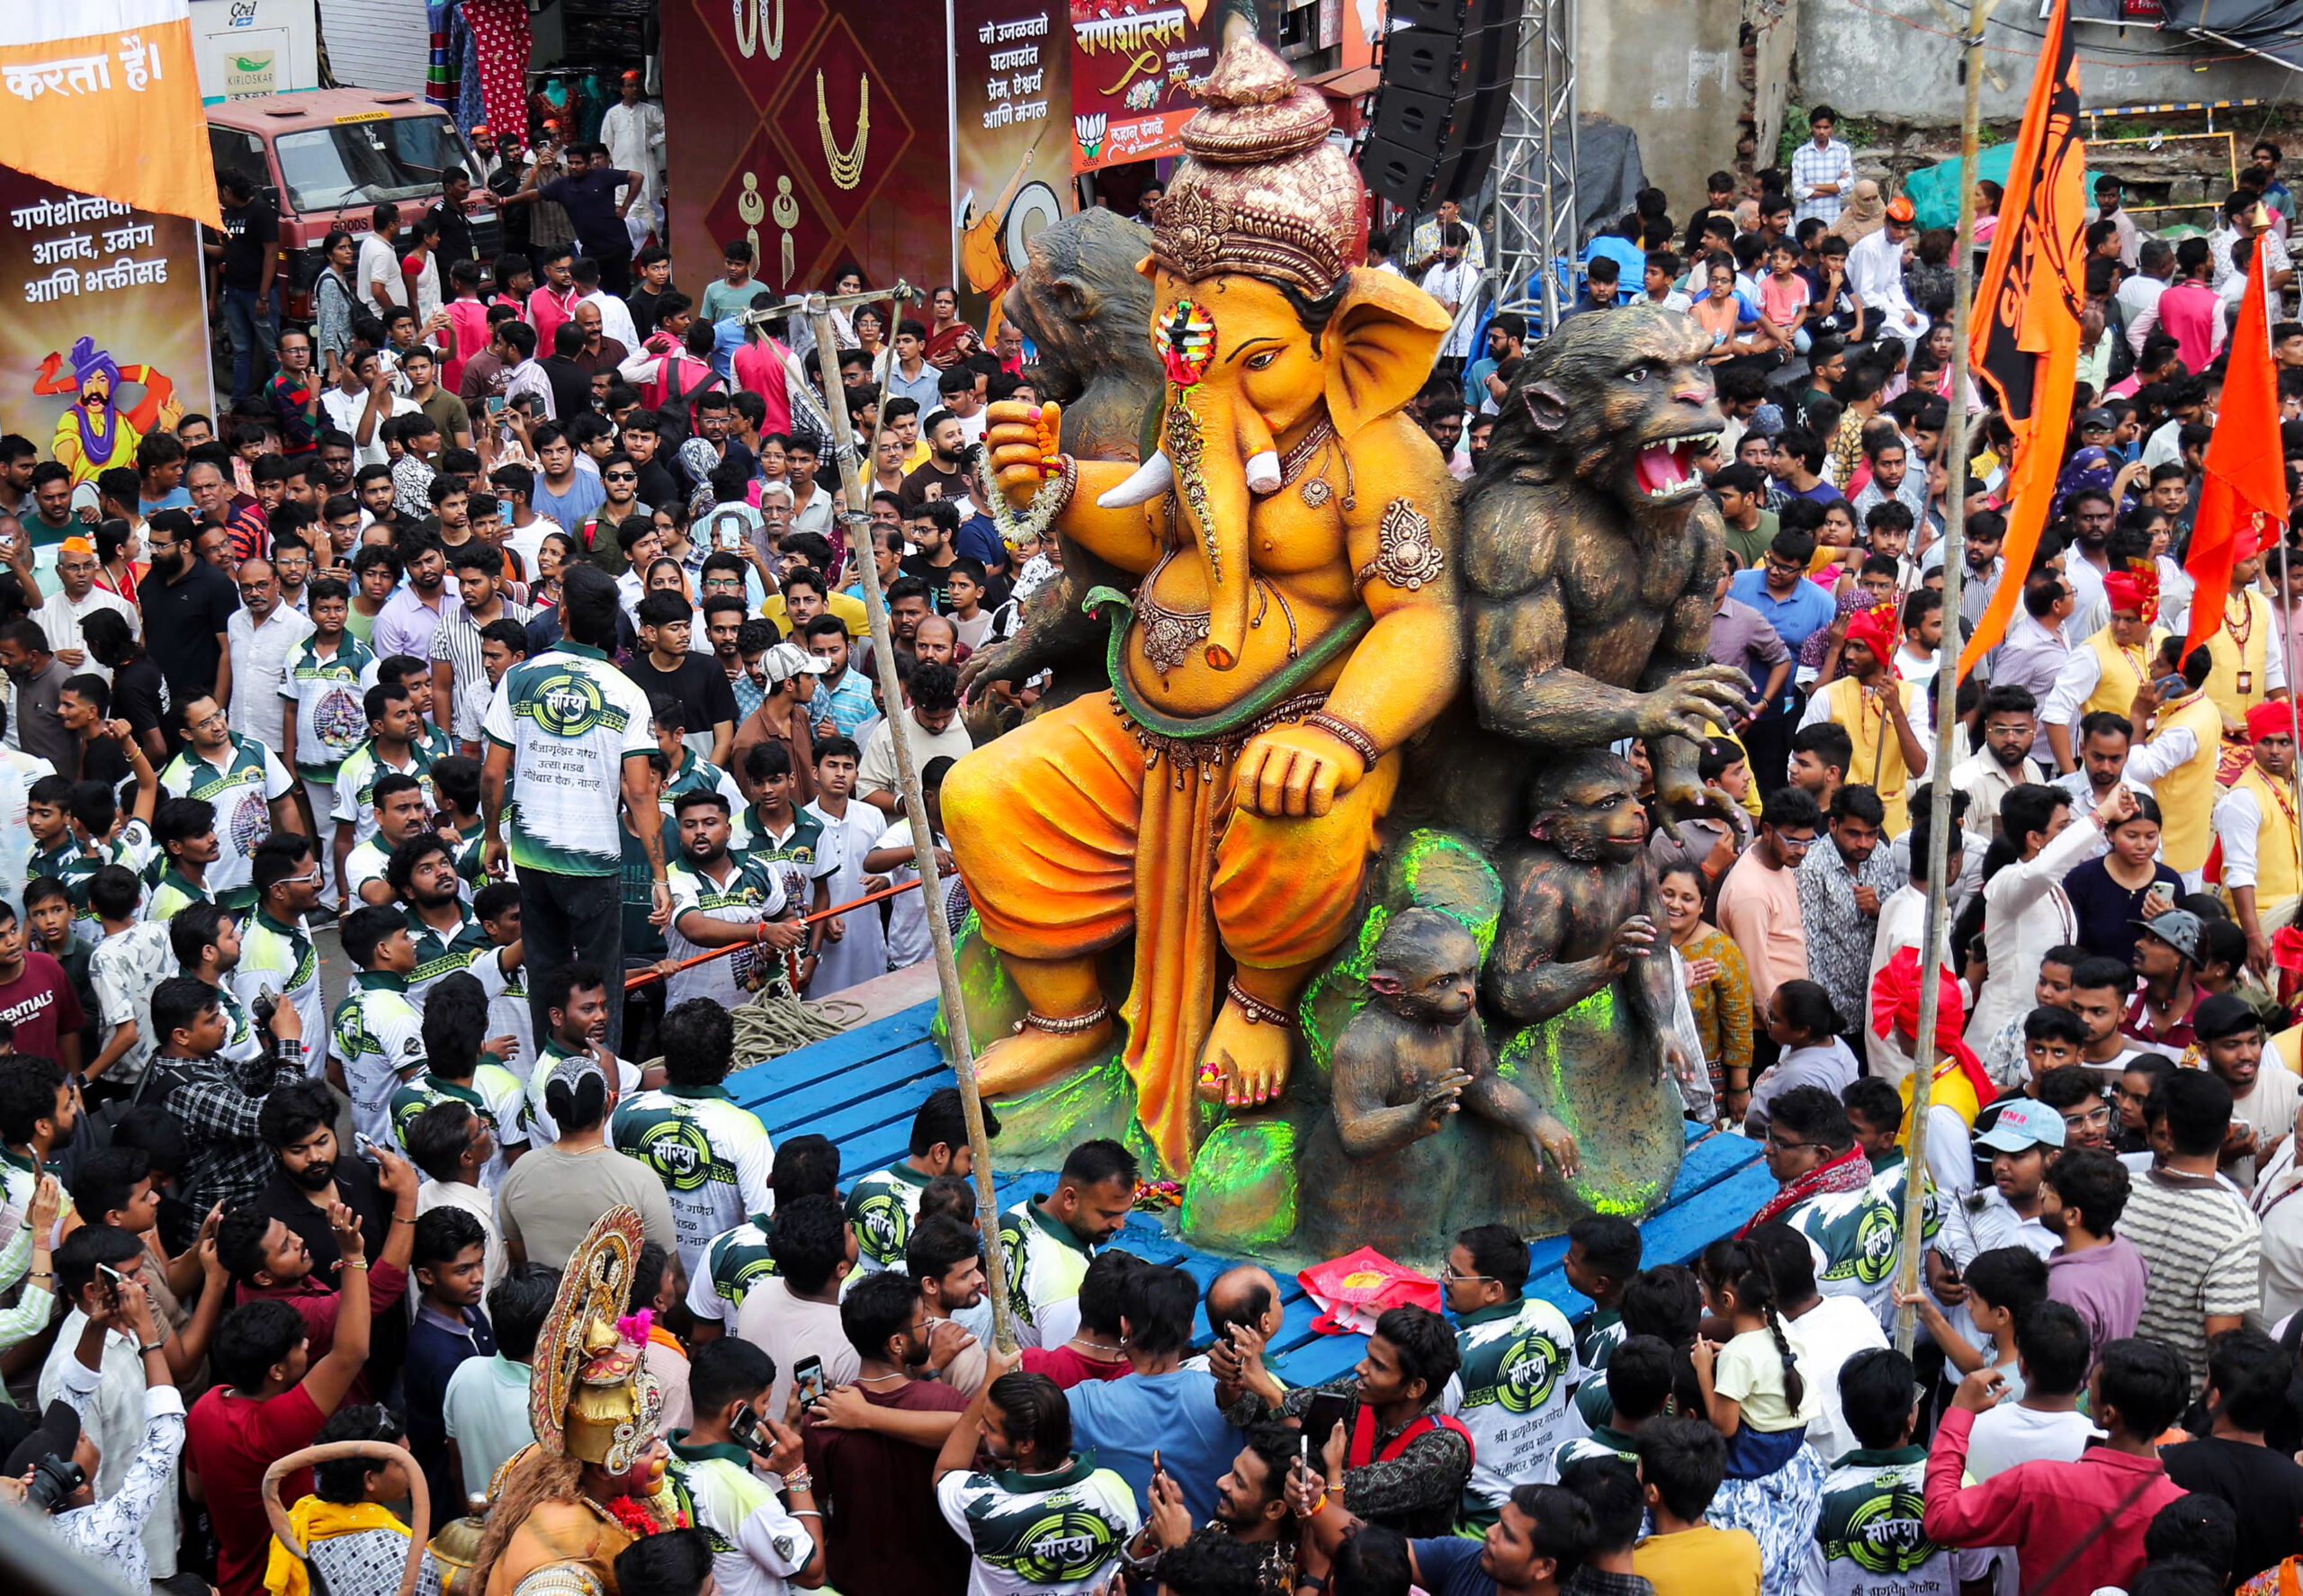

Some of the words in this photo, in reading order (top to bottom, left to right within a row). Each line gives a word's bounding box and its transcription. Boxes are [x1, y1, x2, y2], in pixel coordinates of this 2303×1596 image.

[979, 22, 995, 44] जो
[996, 12, 1048, 42] उजळवतो
[990, 42, 1039, 71] घराघरांत
[2, 53, 112, 101] करता
[228, 72, 273, 86] KIRLOSKAR
[987, 77, 1011, 101] प्रेम,
[1012, 67, 1044, 94] ऐश्वर्य
[983, 102, 1013, 129] आणि
[1015, 100, 1048, 122] मंगल
[331, 219, 368, 233] GOODS
[31, 231, 100, 265] आनंद,
[102, 220, 155, 254] उमंग
[24, 267, 80, 303] आणि
[85, 257, 168, 292] भक्तीसह
